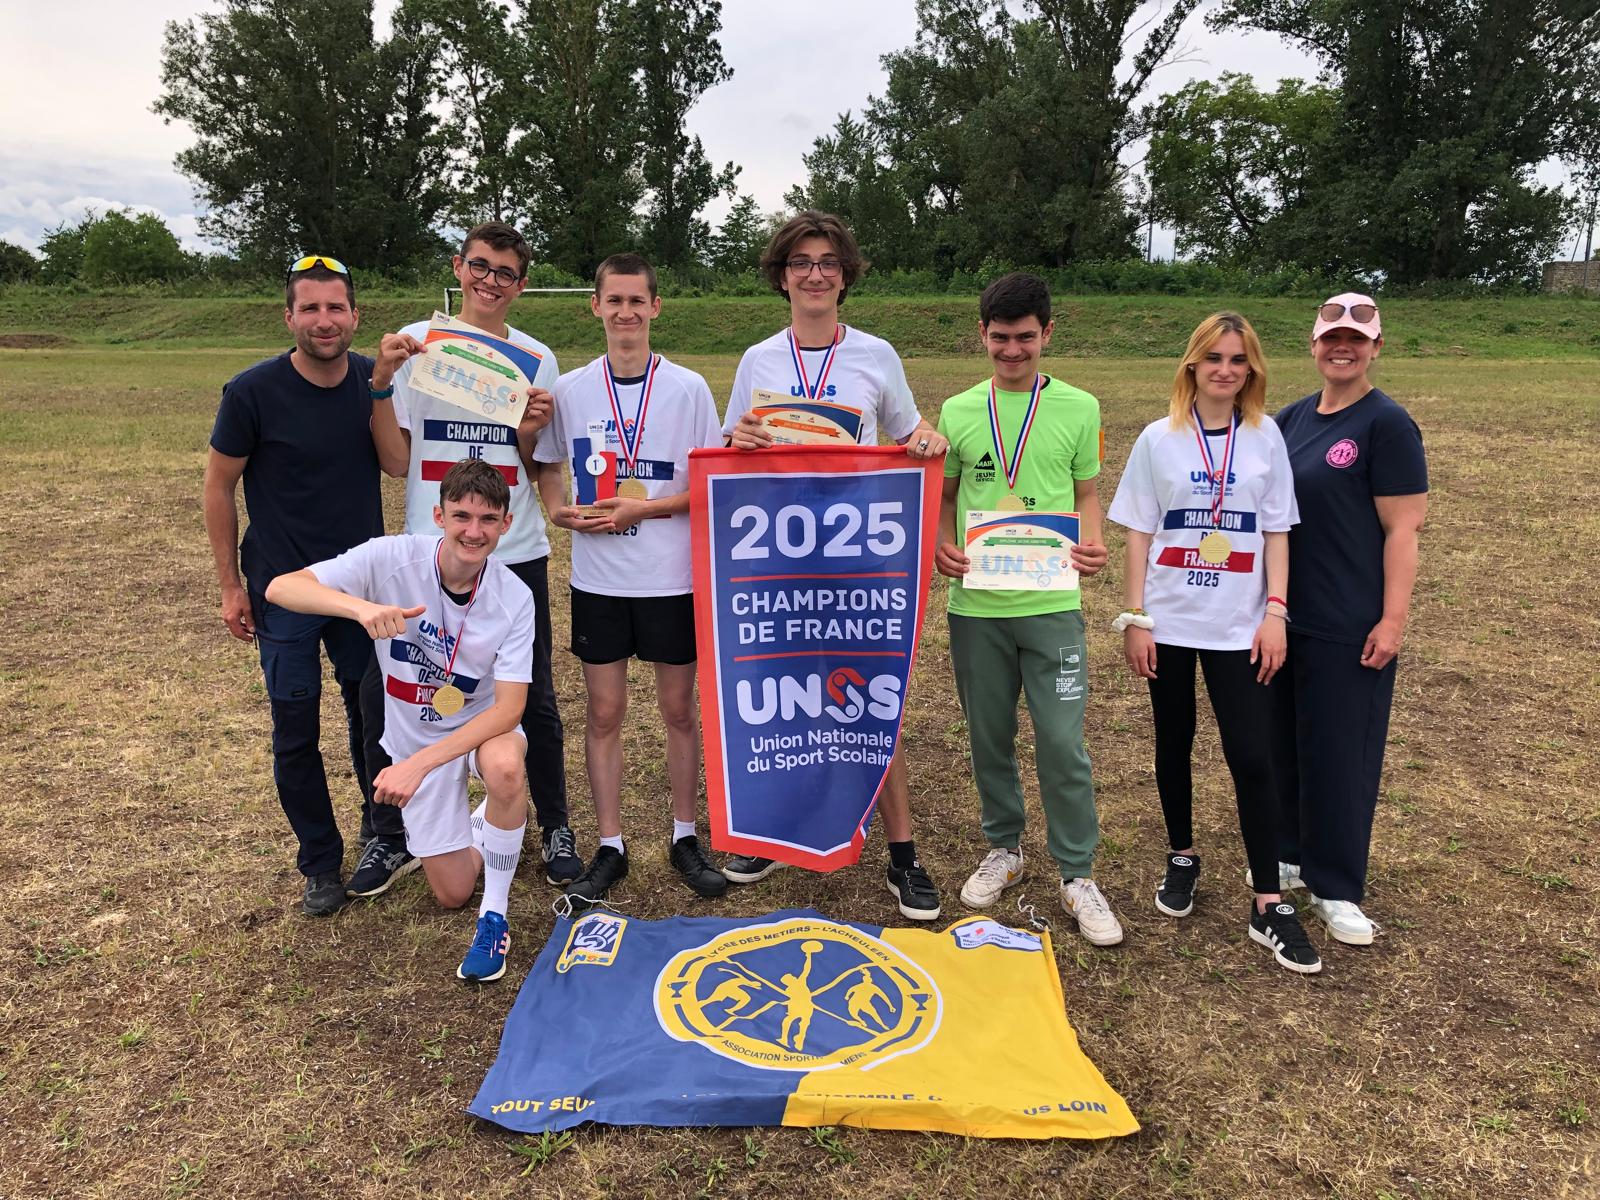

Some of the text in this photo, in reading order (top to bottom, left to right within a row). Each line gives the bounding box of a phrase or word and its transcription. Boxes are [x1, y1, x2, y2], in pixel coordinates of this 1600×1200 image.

[446, 423, 508, 443] CHAMPION
[469, 445, 484, 461] DE
[730, 501, 907, 560] 2025
[1187, 570, 1219, 587] 2025
[732, 588, 907, 615] CHAMPIONS
[738, 618, 902, 645] DE FRANCE
[736, 667, 901, 725] UNSS
[751, 728, 893, 754] Union Nationale
[747, 756, 770, 774] du
[775, 749, 824, 771] Sport
[707, 941, 739, 958] LYCEE
[739, 935, 762, 945] DES
[763, 925, 812, 941] METIERS
[721, 1040, 781, 1062] ASSOCIATION
[491, 1096, 596, 1115] TOUT SEU
[1058, 1100, 1108, 1114] LOIN
